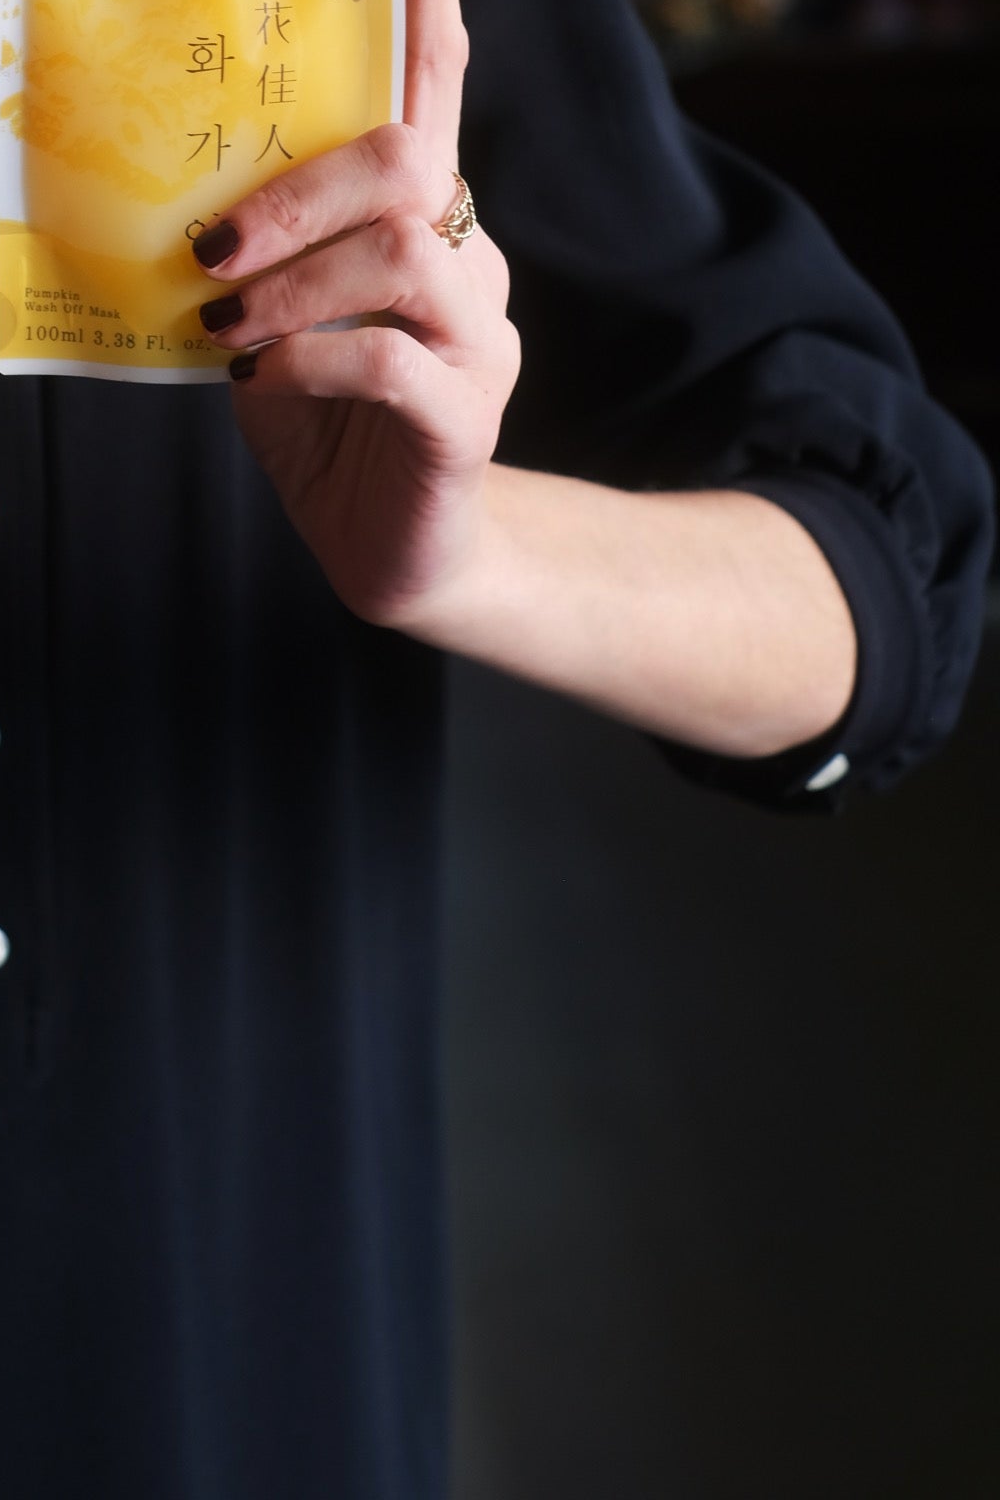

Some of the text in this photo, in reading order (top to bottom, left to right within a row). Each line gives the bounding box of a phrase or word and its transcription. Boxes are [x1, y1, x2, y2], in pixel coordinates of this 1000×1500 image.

[24, 287, 81, 301] Pumpkin
[24, 301, 121, 320] Wash Off Mask
[25, 325, 211, 352] 100ml 3.38 Fl. oz.
